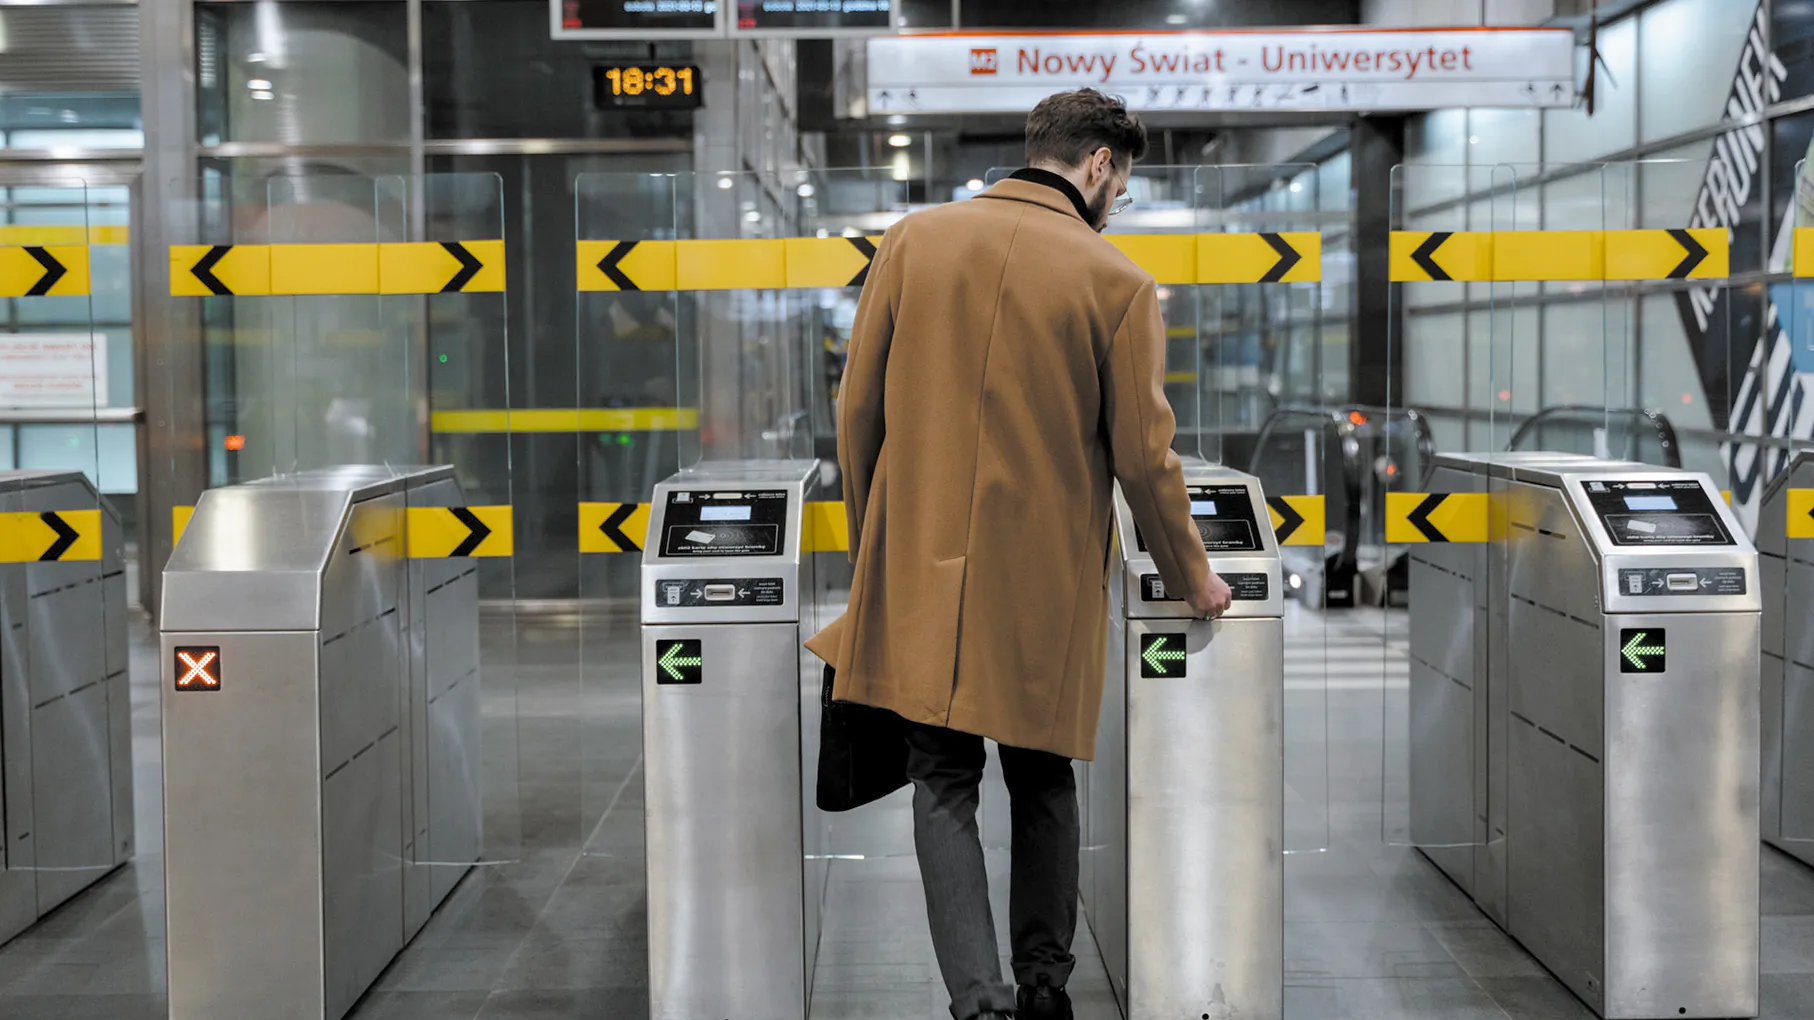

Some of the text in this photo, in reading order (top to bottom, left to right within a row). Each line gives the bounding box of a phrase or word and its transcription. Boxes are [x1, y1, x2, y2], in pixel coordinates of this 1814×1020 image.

[1017, 48, 1117, 83] Nowy
[1130, 38, 1226, 74] Świat
[1261, 44, 1473, 80] Uniwersytet
[605, 66, 693, 96] 18:31
